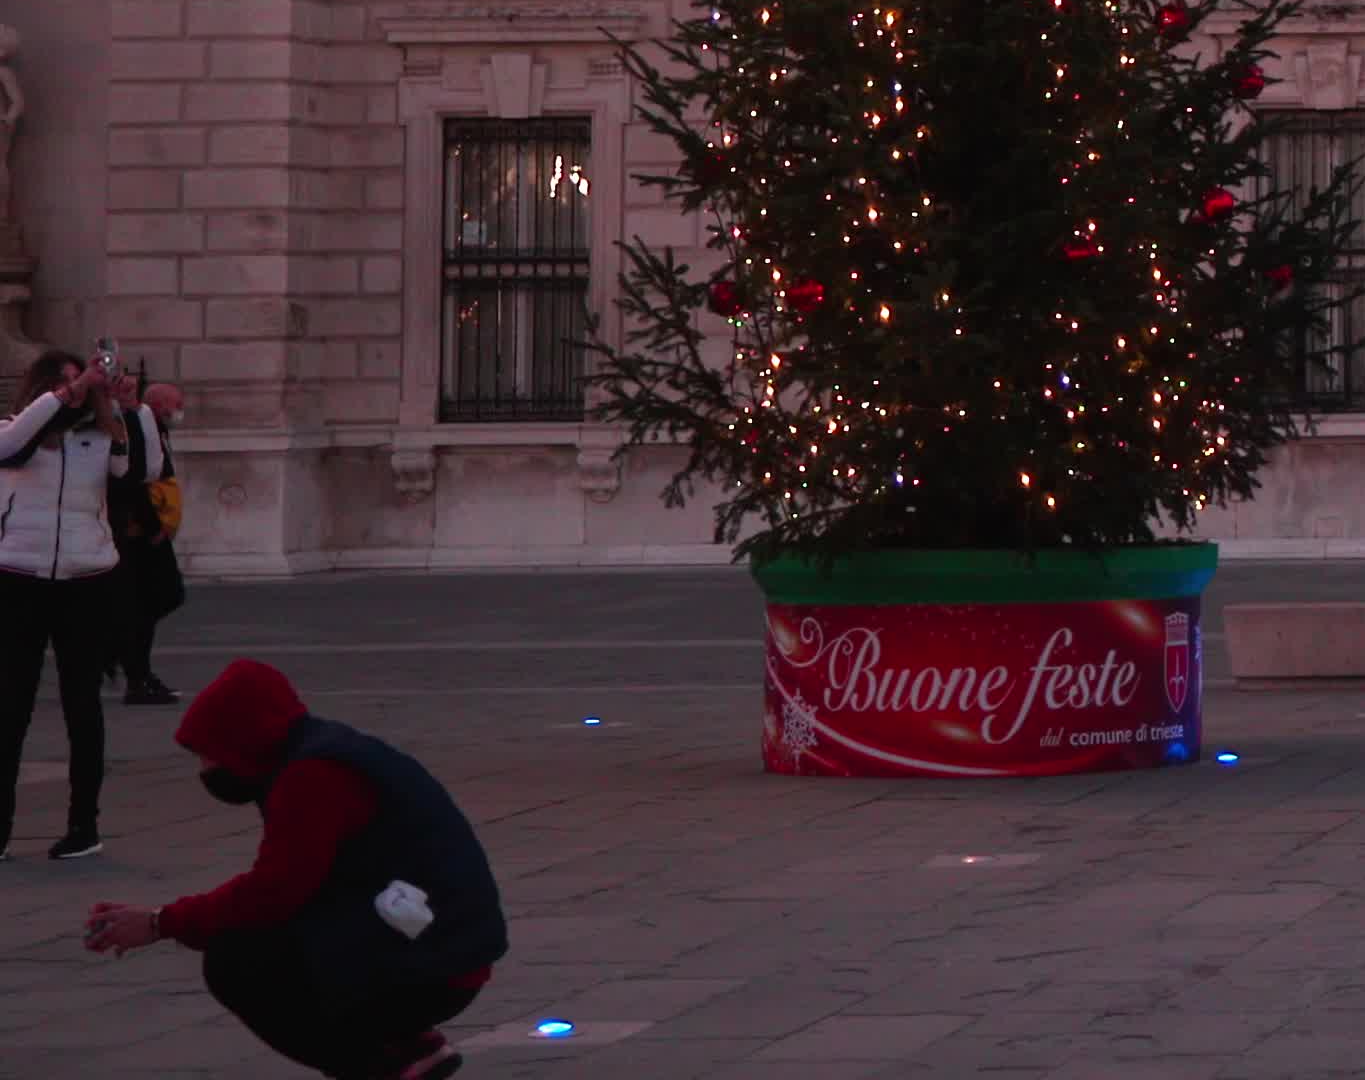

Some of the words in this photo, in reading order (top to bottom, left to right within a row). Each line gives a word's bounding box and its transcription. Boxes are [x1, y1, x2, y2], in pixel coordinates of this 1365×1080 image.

[823, 626, 1016, 713] Buone
[981, 626, 1141, 745] feste
[1069, 728, 1132, 747] comune
[1135, 722, 1148, 743] di
[1150, 721, 1185, 741] trieste
